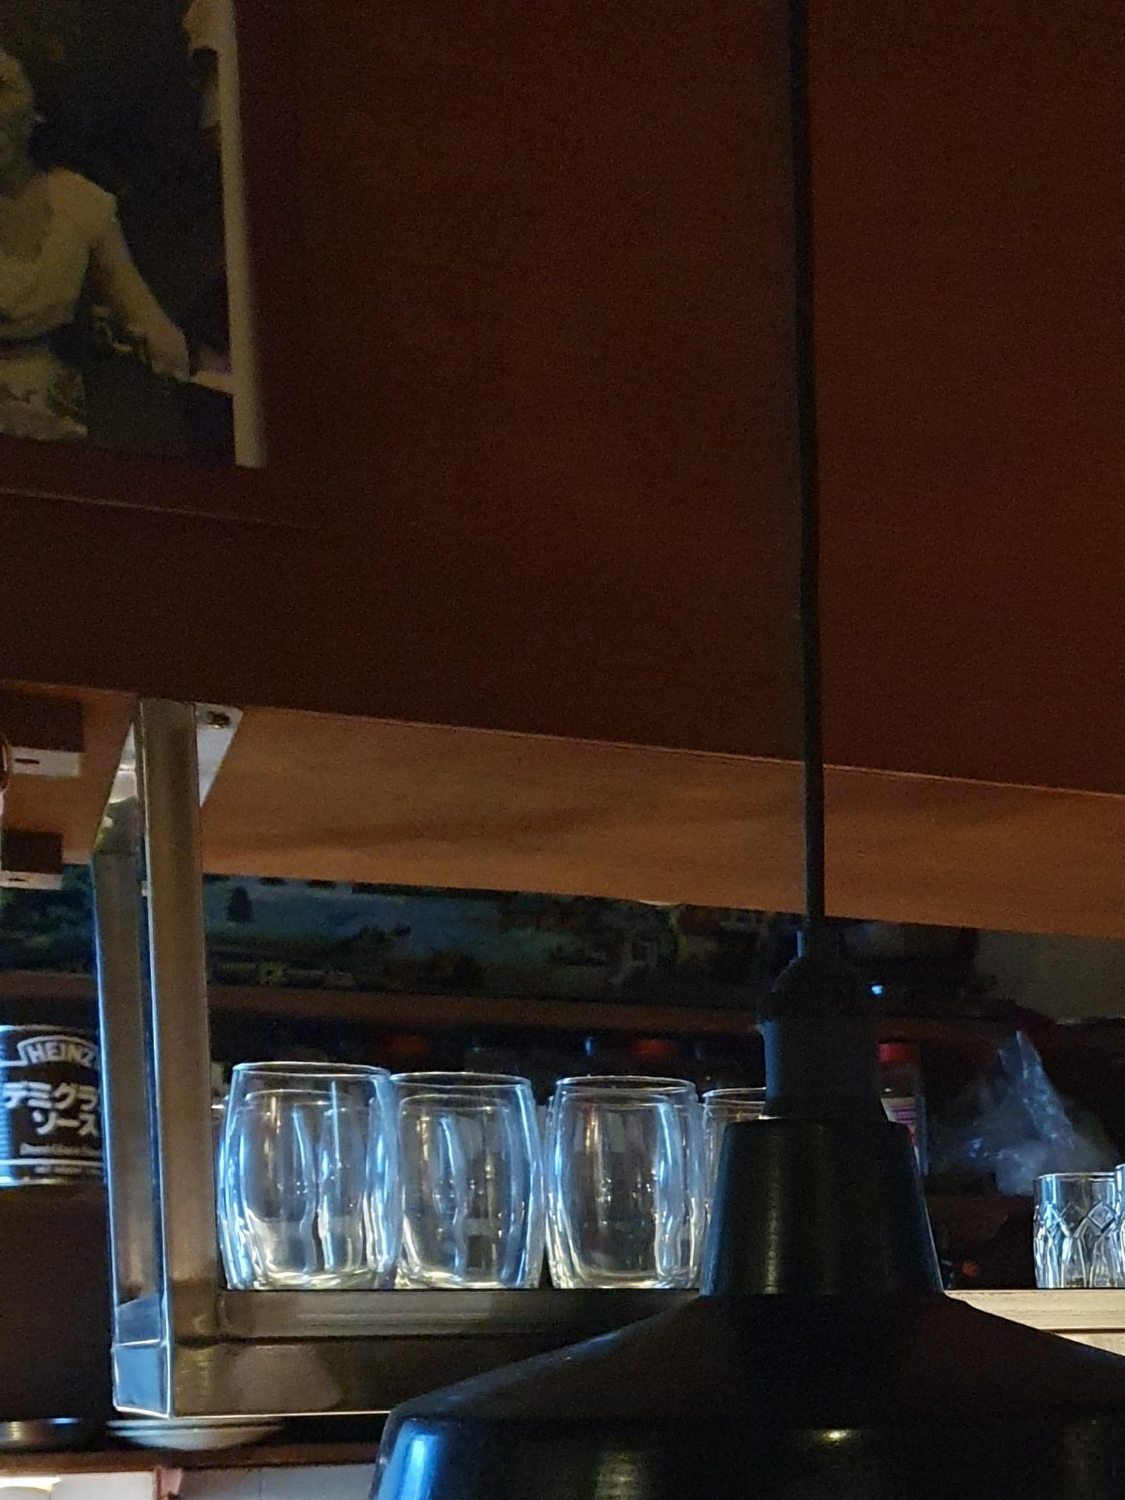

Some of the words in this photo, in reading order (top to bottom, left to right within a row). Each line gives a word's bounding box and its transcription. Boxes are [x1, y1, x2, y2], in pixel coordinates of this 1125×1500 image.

[26, 1040, 97, 1068] HEINZ
[32, 1109, 99, 1137] ソース
